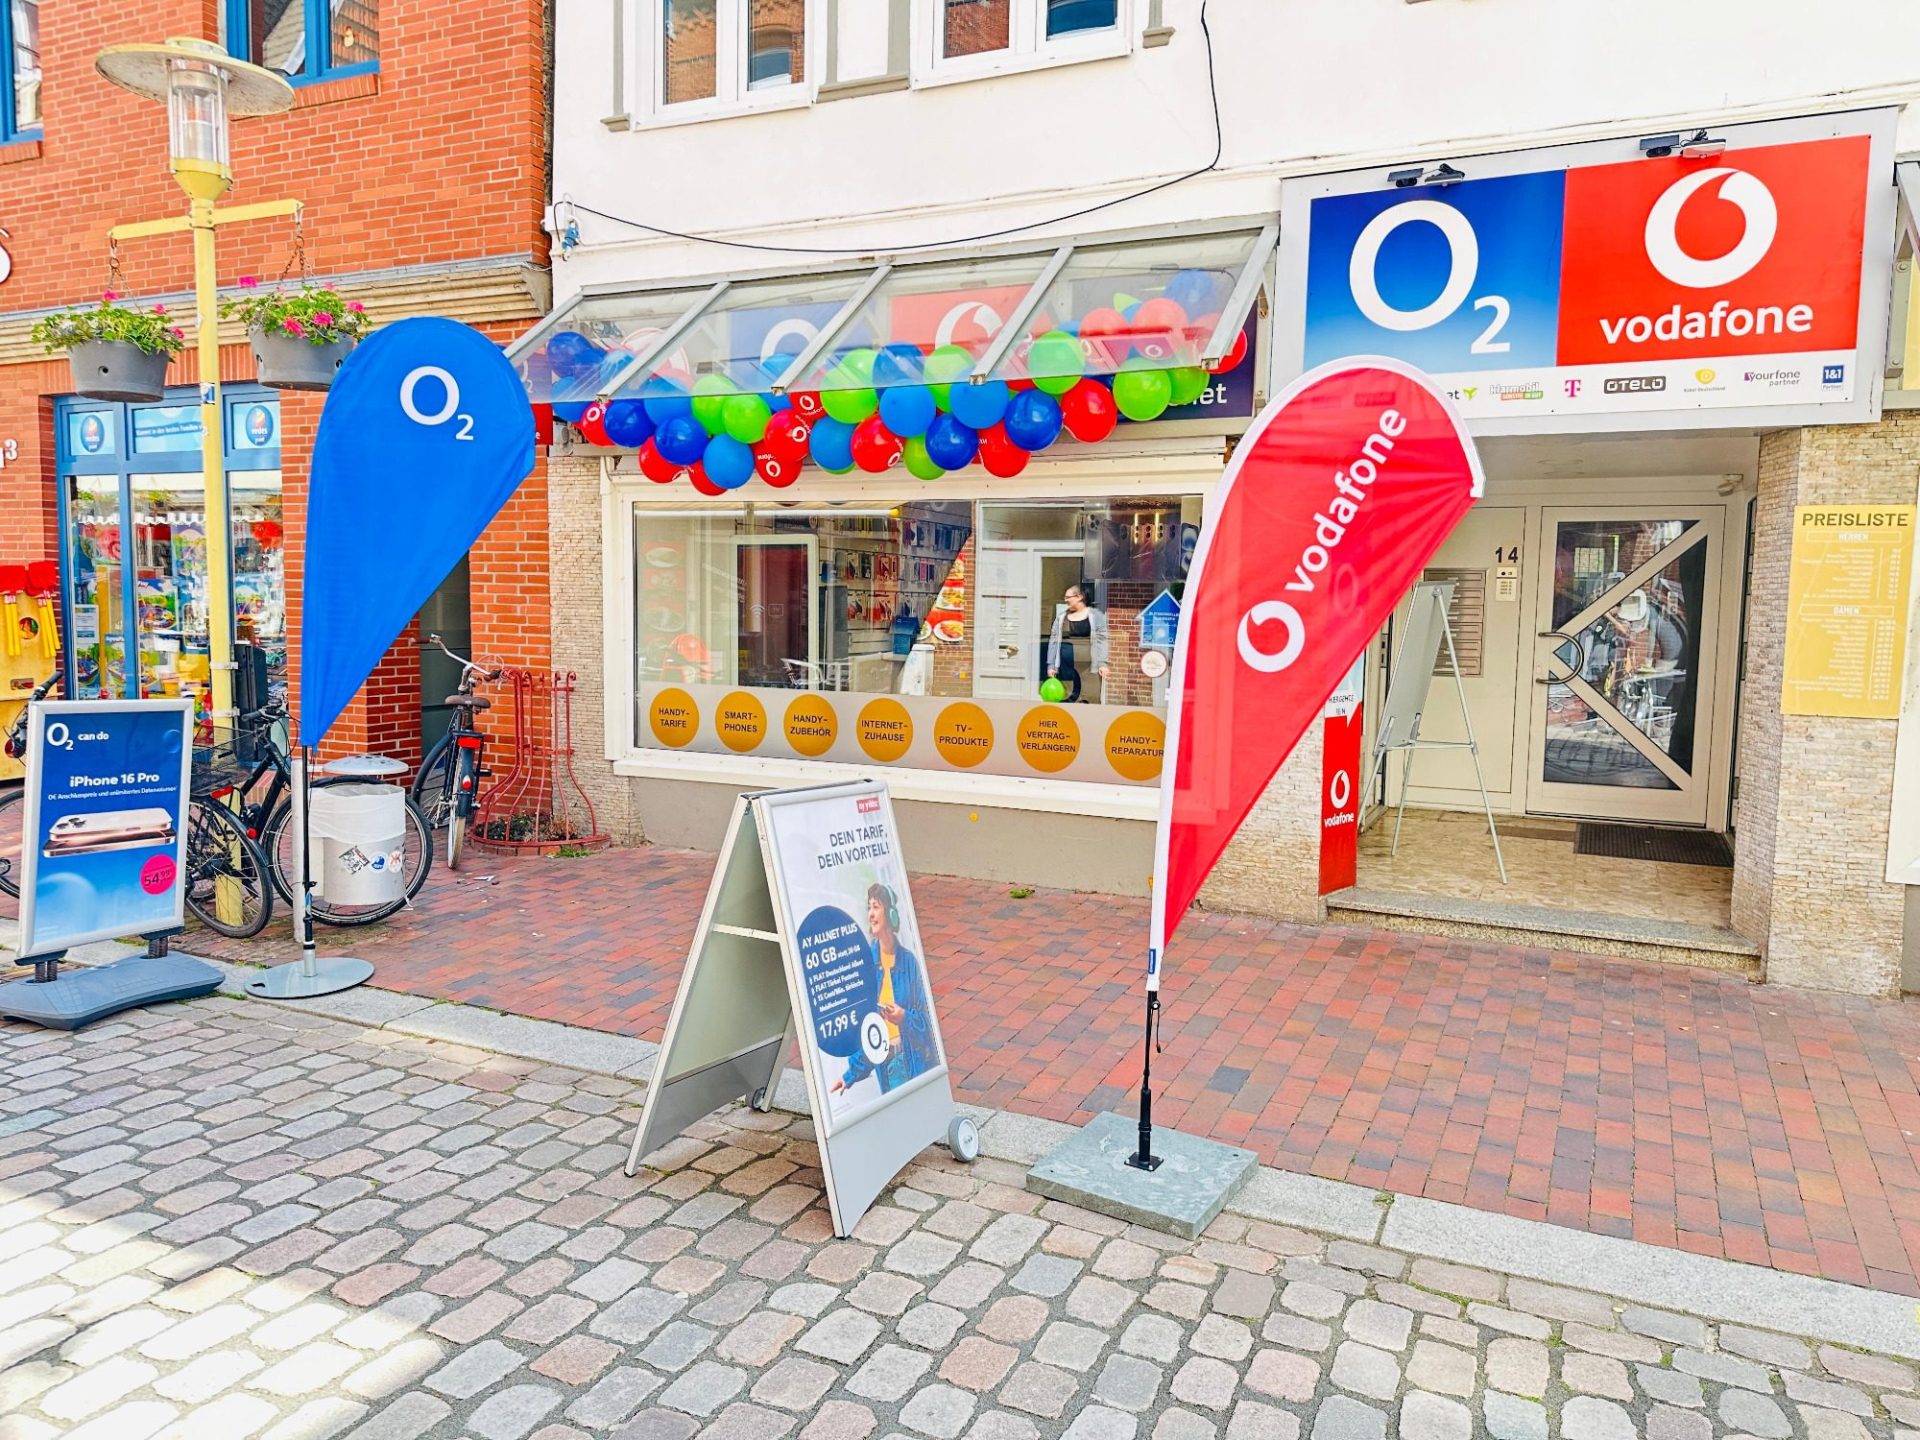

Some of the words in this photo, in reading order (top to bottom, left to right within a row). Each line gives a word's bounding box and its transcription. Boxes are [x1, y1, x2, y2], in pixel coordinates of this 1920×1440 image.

[1349, 199, 1511, 354] O2
[1599, 300, 1813, 344] vodafone
[1824, 369, 1842, 379] 1&1
[400, 366, 474, 441] O2
[1285, 408, 1407, 593] vodafone
[1802, 513, 1909, 527] PREISLISTE
[1495, 546, 1519, 563] 14
[659, 707, 690, 717] HANDY-
[724, 711, 758, 720] SMART-
[793, 714, 828, 723] HANDY-
[660, 718, 687, 728] TARIFE
[724, 723, 757, 733] PHONES
[861, 720, 908, 730] INTERNET-
[955, 724, 973, 733] TV-
[1039, 720, 1058, 728] HIER
[46, 722, 74, 751] O2
[78, 732, 95, 741] can
[96, 731, 109, 740] do
[790, 725, 831, 737] ZUBEHÖR
[864, 731, 905, 742] ZUHAUSE
[1026, 731, 1070, 740] VERTRAG-
[939, 735, 988, 747] PRODUKTE
[1119, 735, 1157, 745] HANDY-
[69, 774, 118, 788] iPhone
[121, 773, 135, 784] 16
[137, 772, 160, 783] Pro
[98, 789, 109, 797] und
[1324, 812, 1355, 828] vodafone
[830, 829, 855, 847] DEIN
[856, 824, 888, 843] TARIF,
[818, 850, 843, 870] DEIN
[844, 842, 890, 864] VORTEIL!
[802, 936, 812, 949] AY
[814, 927, 840, 946] ALLNET
[840, 922, 858, 937] PLUS
[806, 952, 820, 970] 60
[821, 946, 837, 964] GB
[819, 1014, 849, 1039] 17,99
[850, 1010, 858, 1026] €
[867, 1023, 889, 1052] O2
